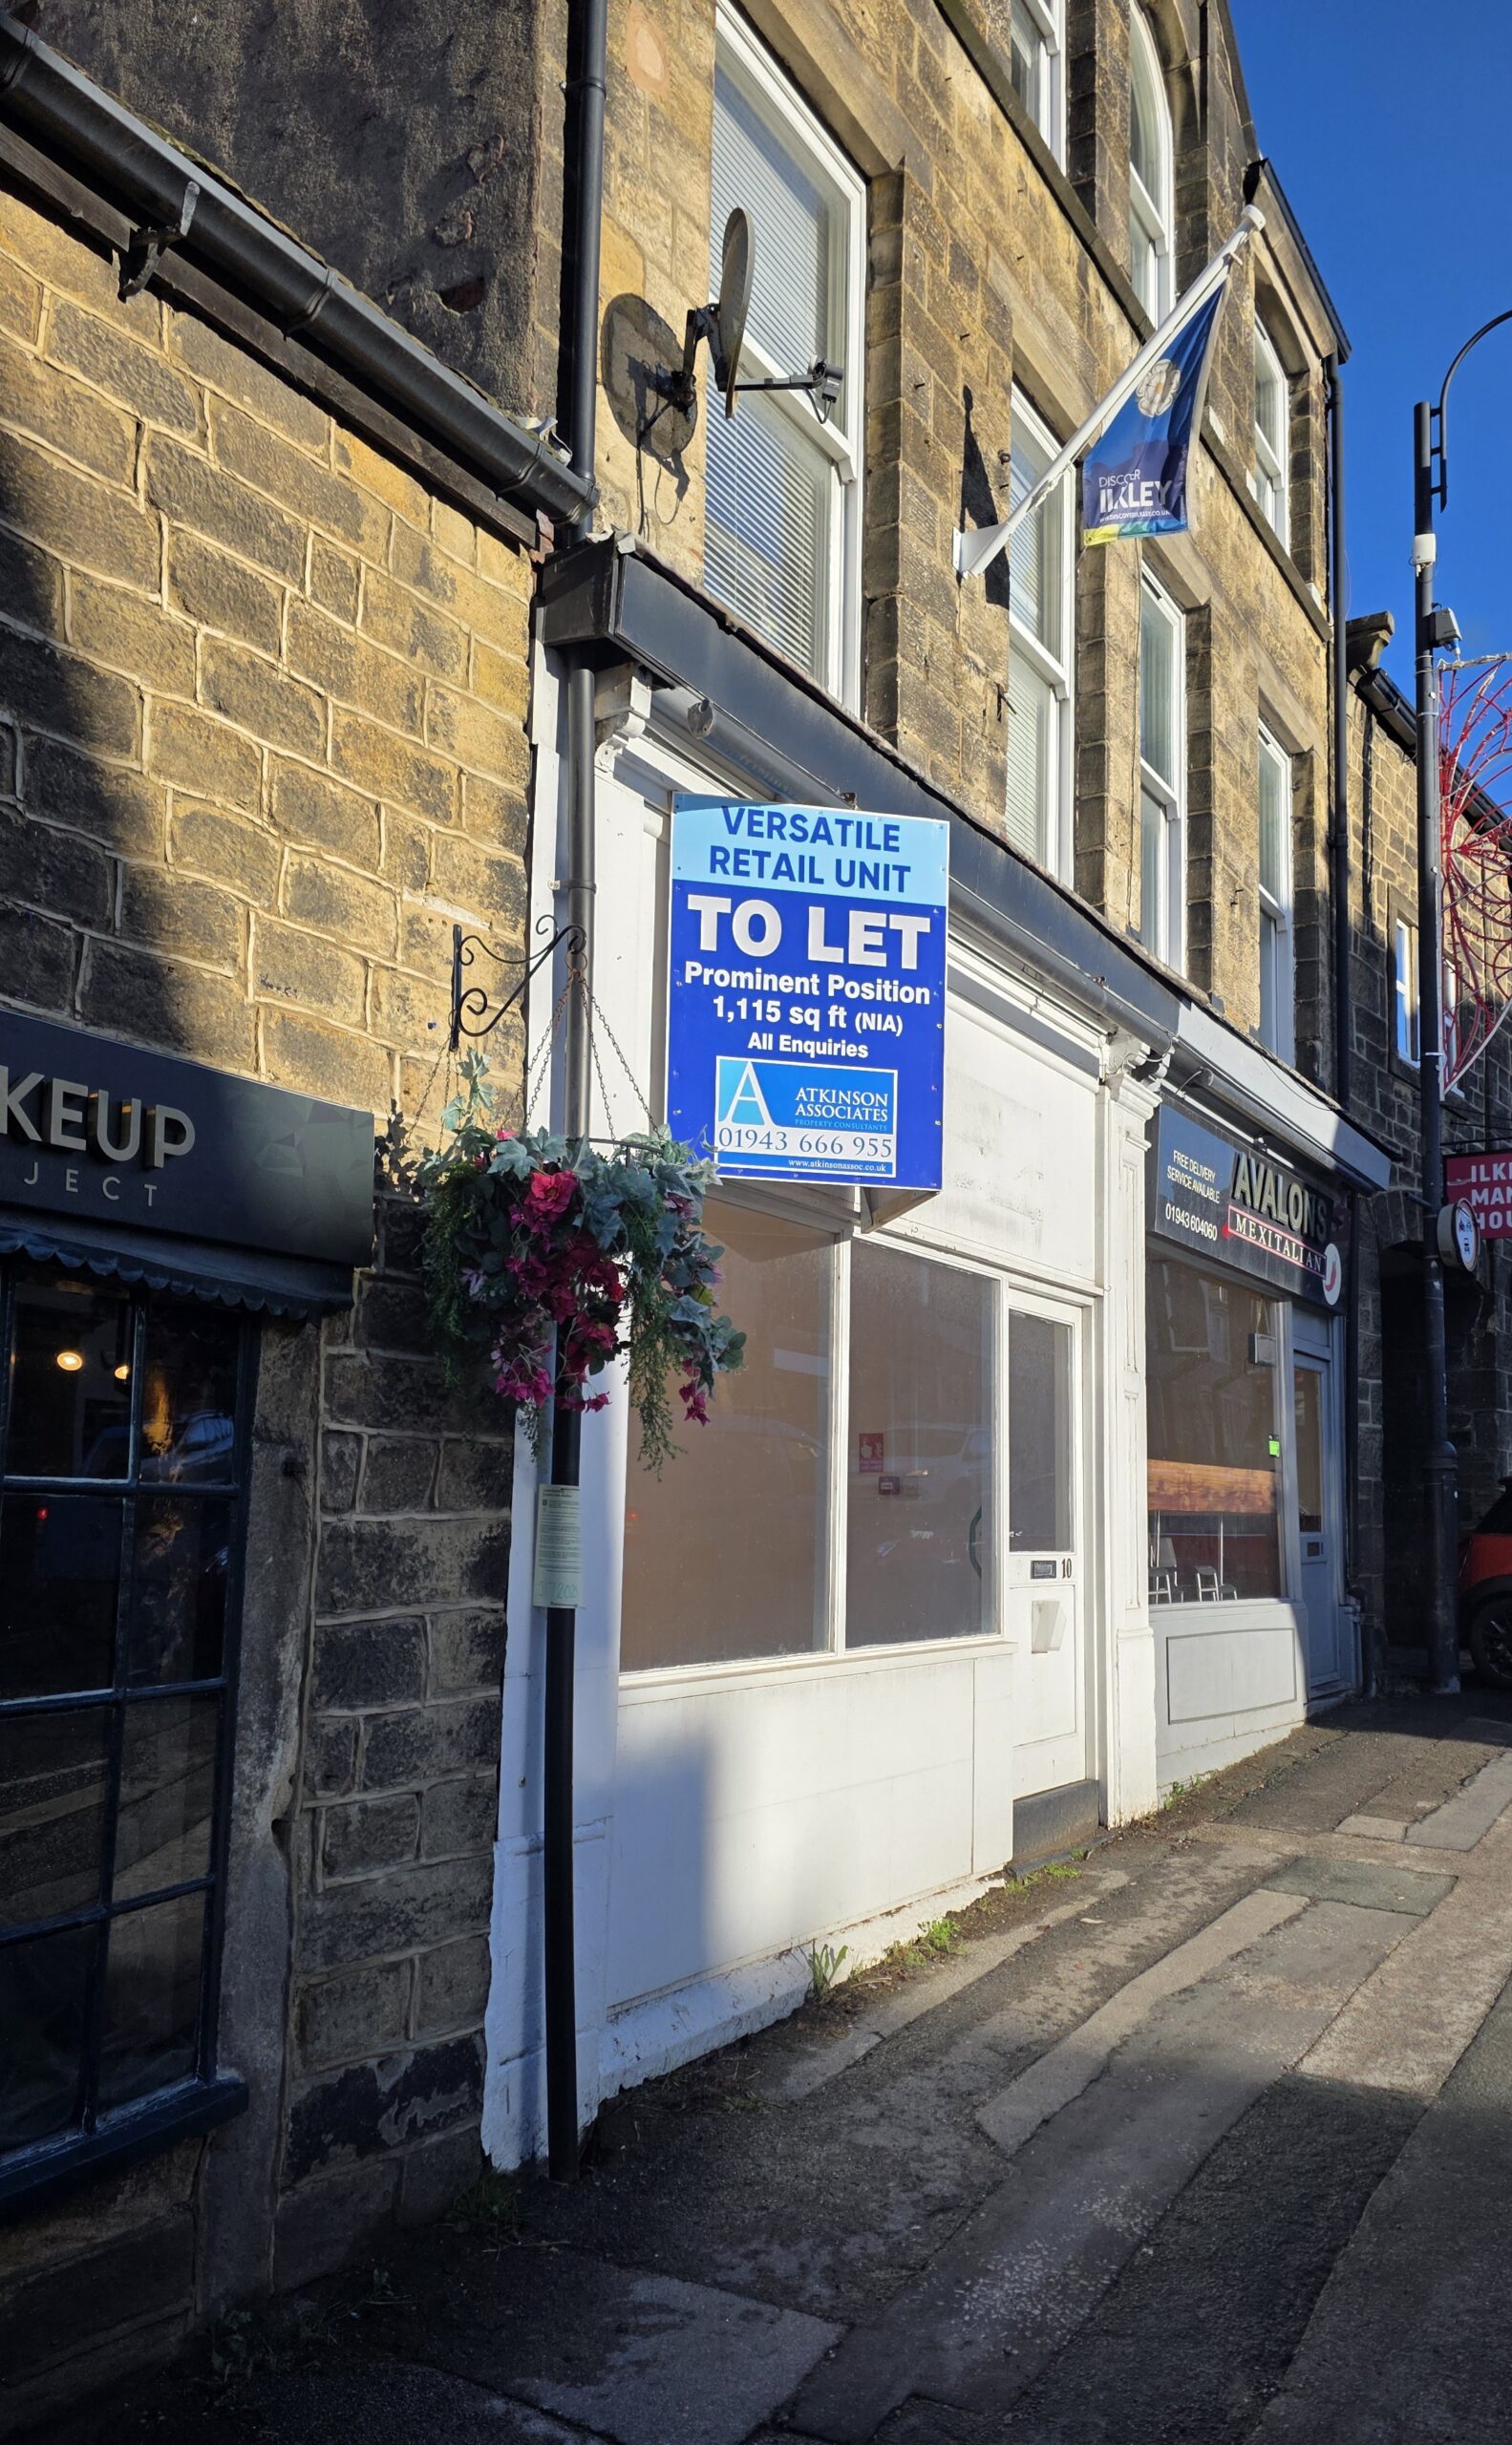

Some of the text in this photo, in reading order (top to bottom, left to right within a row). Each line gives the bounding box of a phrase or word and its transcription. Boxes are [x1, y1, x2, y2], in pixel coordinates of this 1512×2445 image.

[1099, 469, 1140, 487] DISCOER
[722, 805, 902, 853] VERSATILE
[710, 845, 911, 894] RETAIL UNIT
[687, 893, 931, 970] TO LET
[684, 961, 931, 1006] Prominent Position
[713, 995, 904, 1037] 1,115 sq ft (NIA)
[748, 1031, 869, 1059] All Enquiries
[795, 1087, 889, 1108] ATKINSON
[795, 1103, 889, 1122] ASSOCIATES
[718, 1127, 892, 1159] 01943 666 955
[795, 1118, 887, 1132] PROPERTY CONSULTANTS
[788, 1158, 886, 1172] www.atkinsonassoc.co.uk
[1173, 1149, 1216, 1183] FREE DELIVERY
[1471, 1161, 1512, 1182] ILK
[24, 1161, 158, 1207] JECT
[1167, 1165, 1221, 1204] SERVICE AVAILABLE
[1233, 1153, 1327, 1242] AVALONS
[1165, 1203, 1218, 1242] 01943 604060
[1235, 1213, 1323, 1273] MEXITALIAN
[1061, 1558, 1073, 1579] 10
